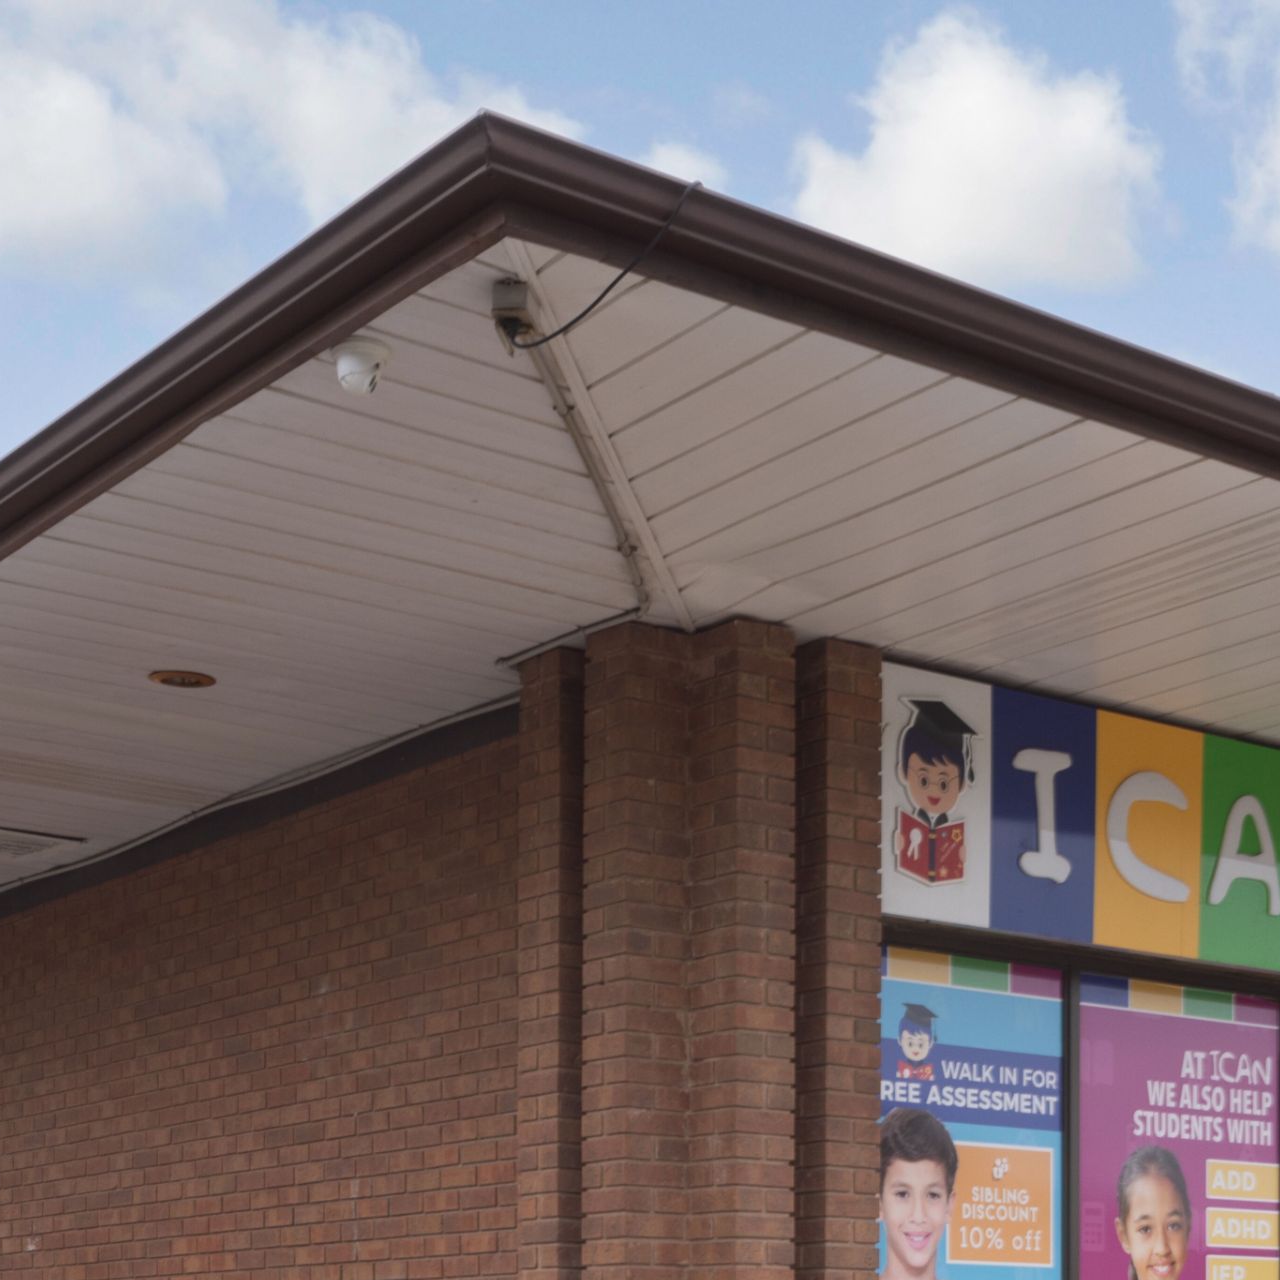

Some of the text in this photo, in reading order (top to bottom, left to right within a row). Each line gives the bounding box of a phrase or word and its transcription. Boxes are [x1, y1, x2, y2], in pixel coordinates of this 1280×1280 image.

[941, 1060, 1058, 1089] WALK IN FOR
[1181, 1050, 1273, 1085] AT ICAN
[880, 1080, 1058, 1116] REE ASSESSMENT
[1147, 1080, 1273, 1116] WE ALSO HELP
[1133, 1110, 1273, 1146] STUDENTS WITH
[1212, 1169, 1257, 1192] ADD
[972, 1186, 1029, 1205] SIBLING
[962, 1203, 1038, 1222] DISCOUNT
[960, 1226, 1042, 1251] 10% off
[1212, 1217, 1271, 1240] ADHD
